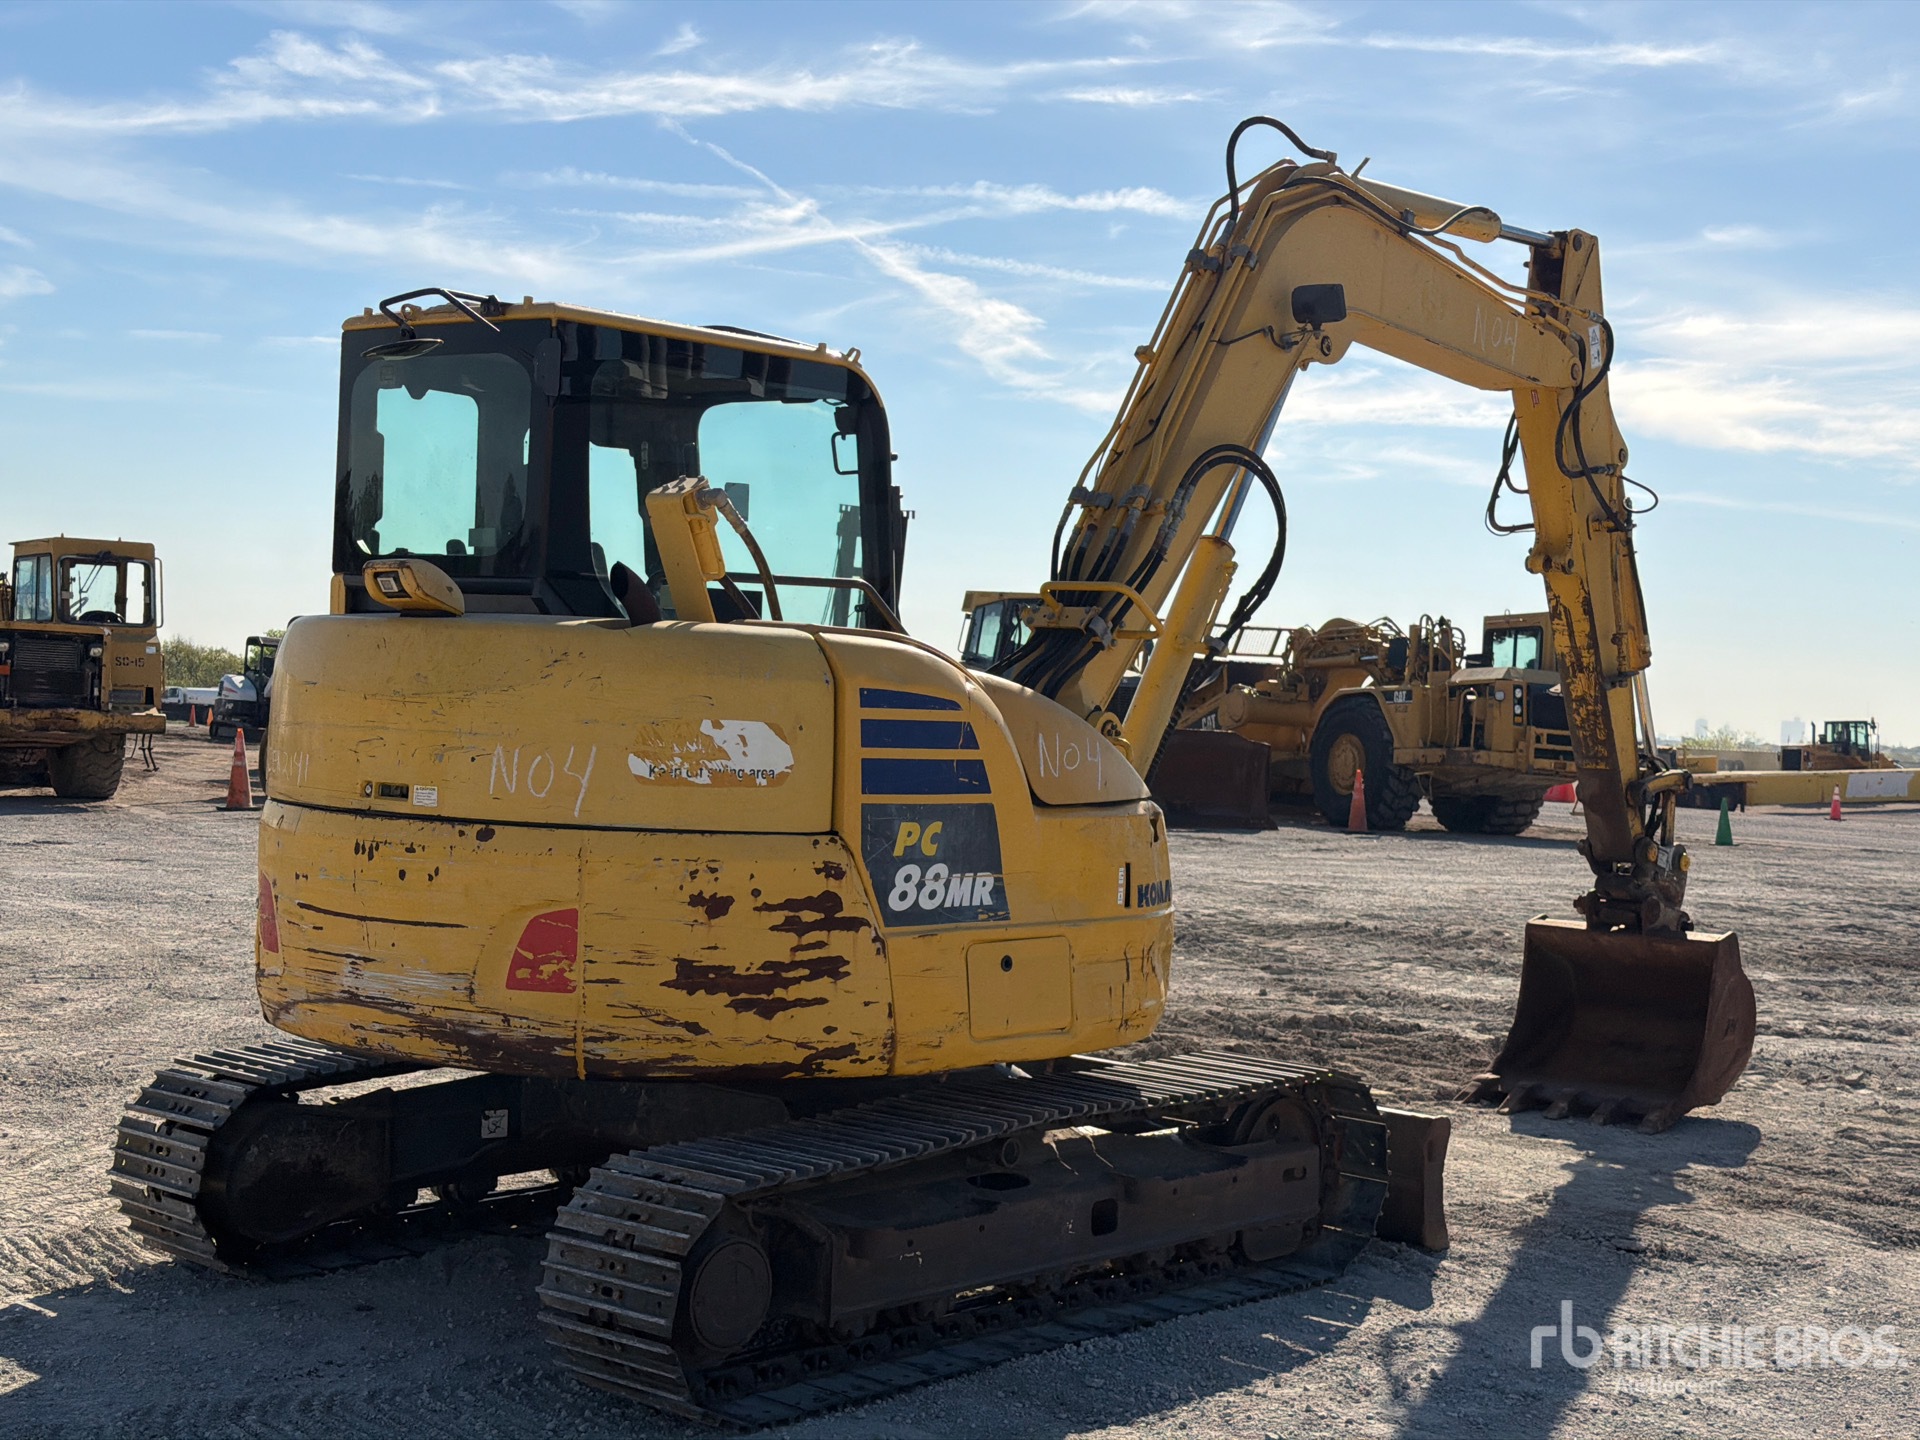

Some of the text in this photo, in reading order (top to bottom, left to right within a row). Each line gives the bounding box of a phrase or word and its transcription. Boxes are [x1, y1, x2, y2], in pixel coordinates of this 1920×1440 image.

[1394, 691, 1406, 703] CAT
[749, 769, 775, 780] area
[893, 821, 943, 857] PC
[888, 863, 994, 911] 88MR
